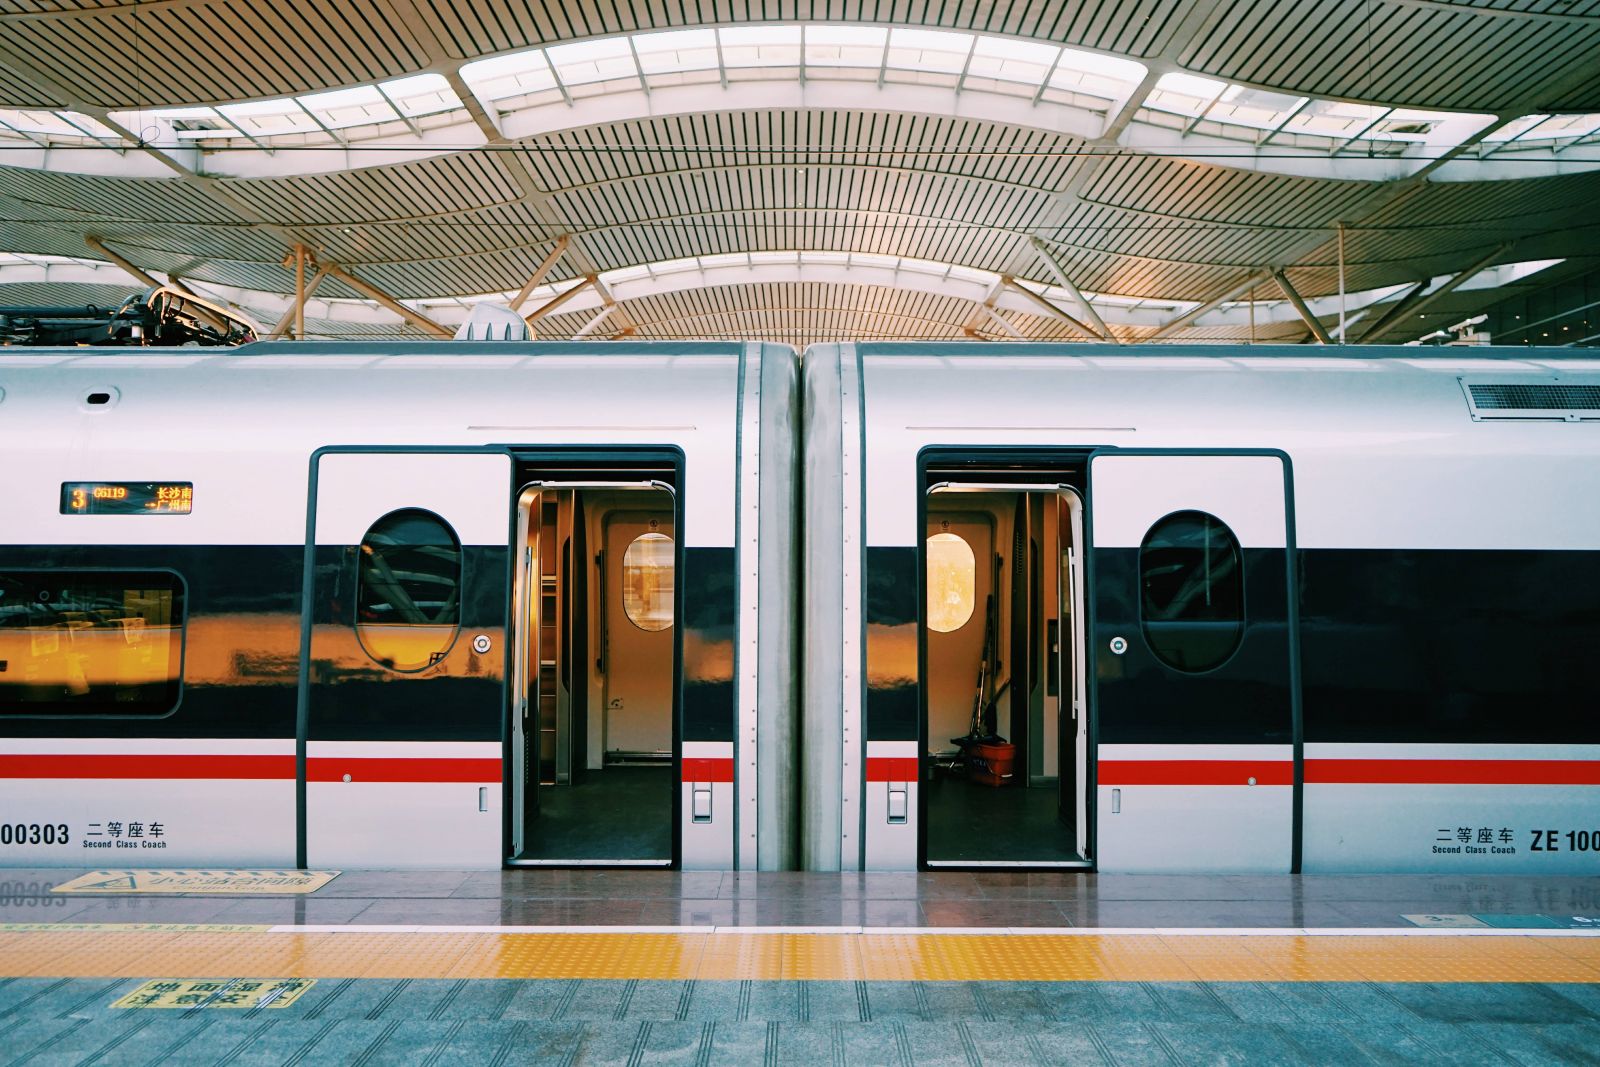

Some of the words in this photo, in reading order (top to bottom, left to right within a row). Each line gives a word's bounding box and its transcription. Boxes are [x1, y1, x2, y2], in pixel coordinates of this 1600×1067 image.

[72, 488, 86, 508] 3
[157, 487, 192, 499] 长沙南
[156, 500, 191, 512] 广州南
[1, 823, 69, 845] 00303
[86, 821, 165, 839] 二等座车
[1436, 827, 1514, 844] 二等座车
[83, 840, 112, 849] Second
[116, 840, 138, 849] Class
[142, 840, 167, 849] Coach
[1530, 830, 1559, 851] ZE
[1432, 845, 1461, 854] Second
[1465, 845, 1487, 854] Class
[1491, 845, 1516, 854] Coach
